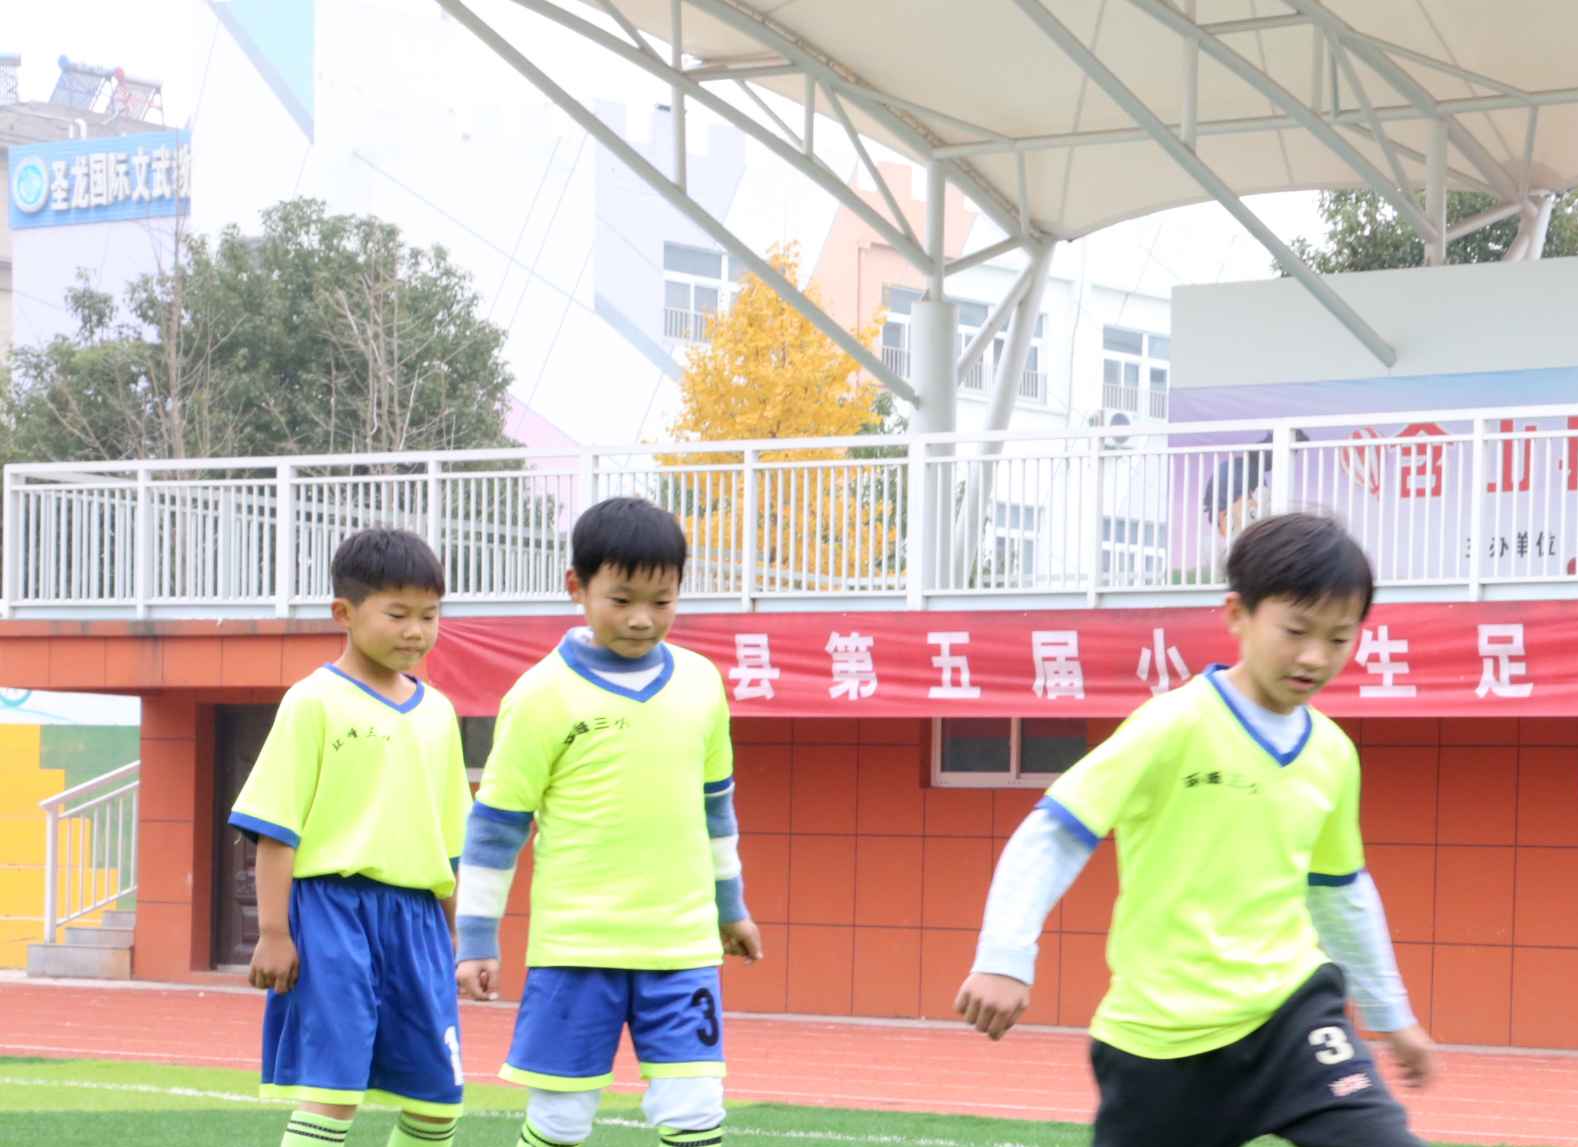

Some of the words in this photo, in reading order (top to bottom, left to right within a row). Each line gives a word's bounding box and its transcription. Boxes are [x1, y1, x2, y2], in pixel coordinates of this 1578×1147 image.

[691, 987, 719, 1047] 3
[1307, 1026, 1355, 1065] 3
[443, 1025, 464, 1086] 1
